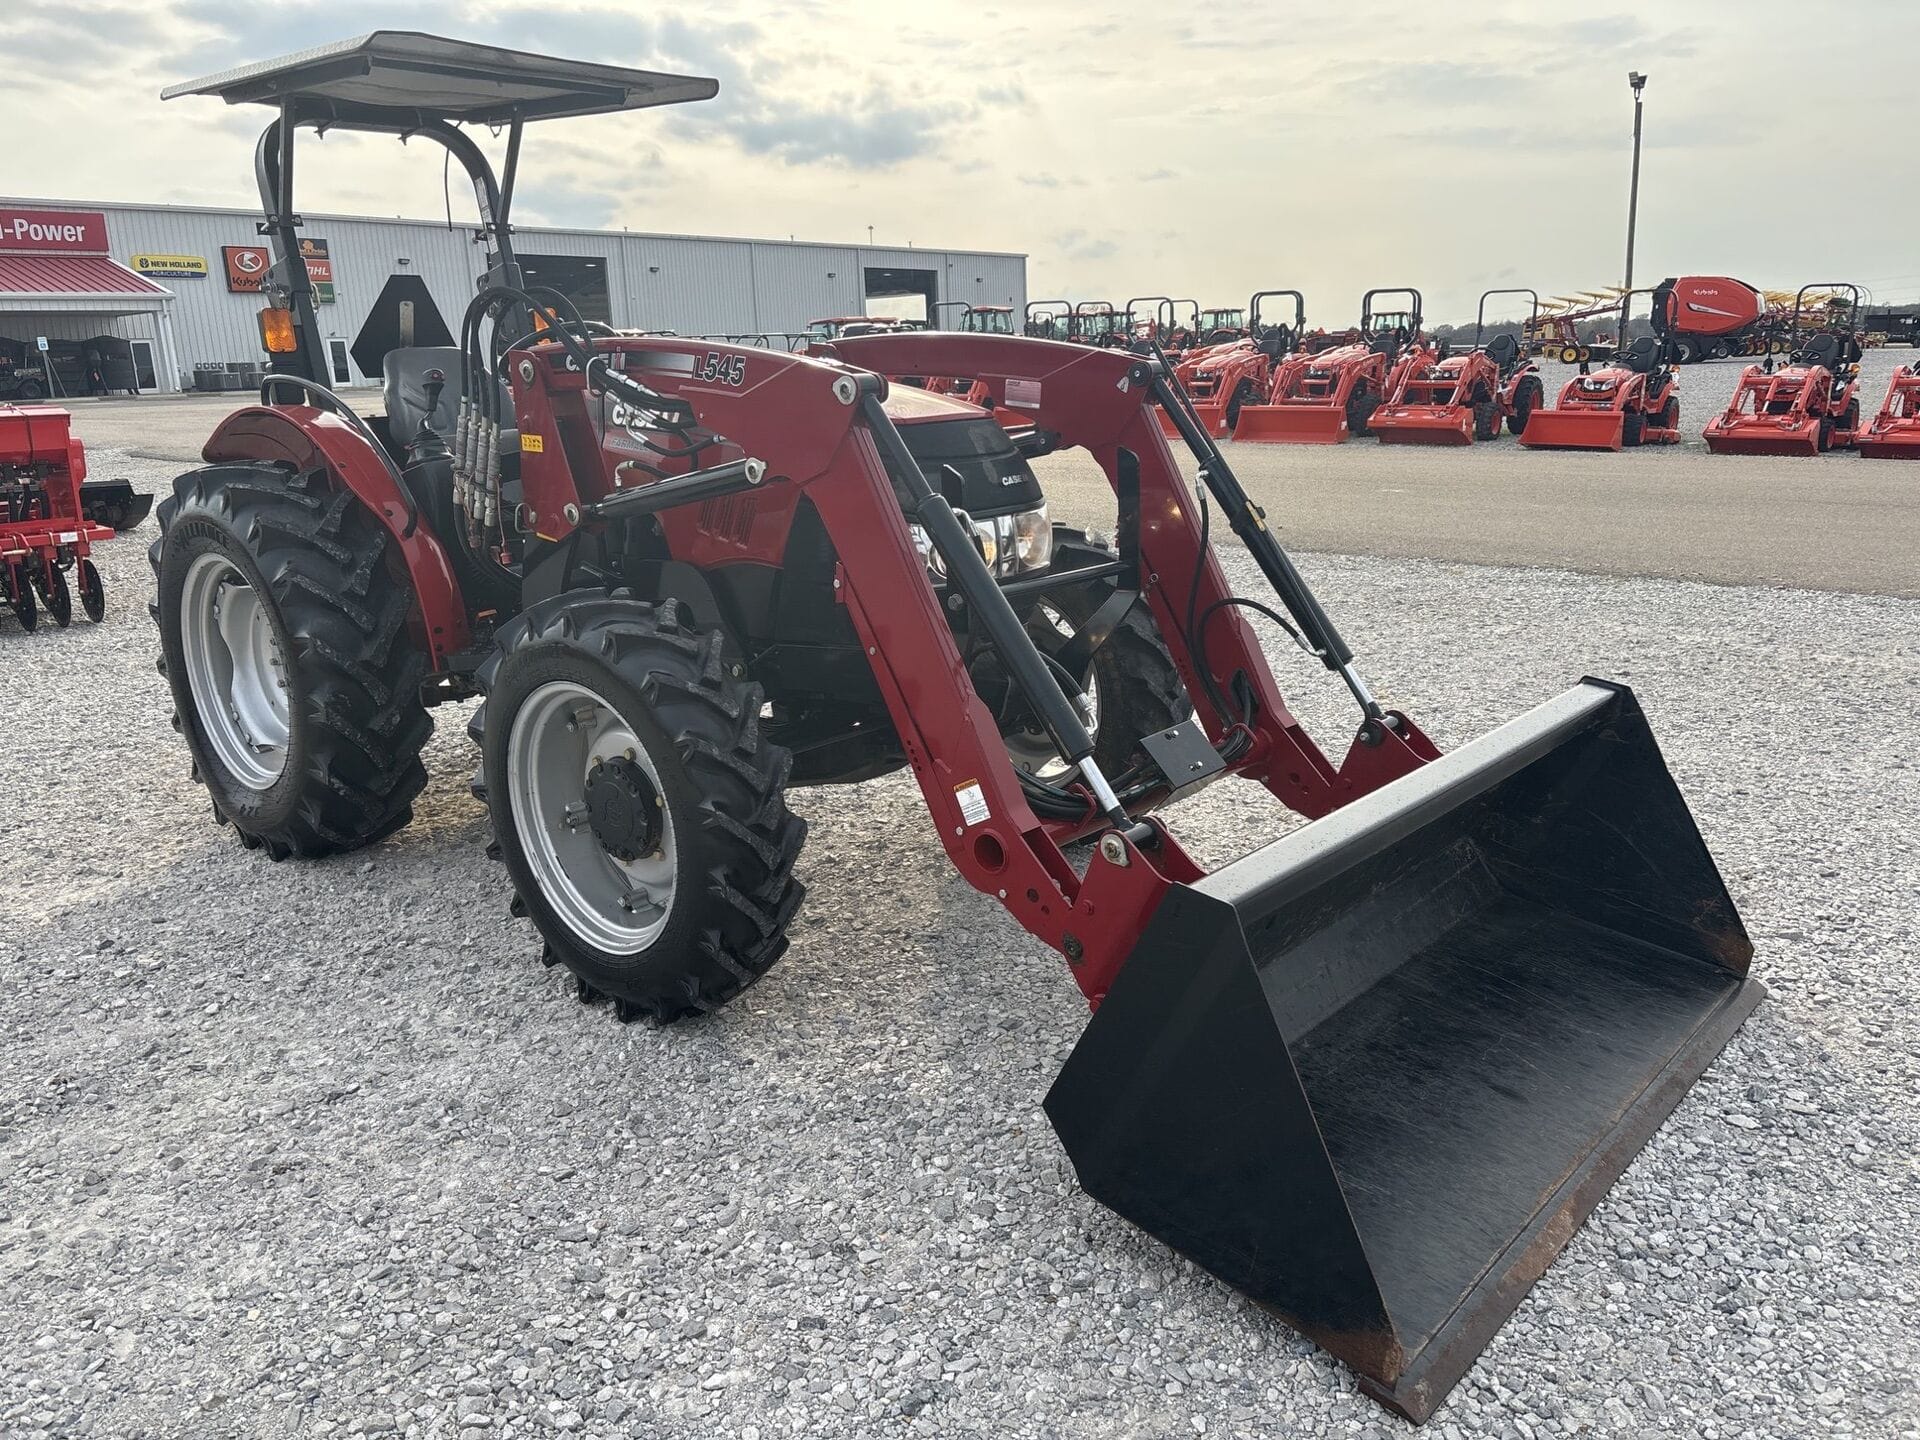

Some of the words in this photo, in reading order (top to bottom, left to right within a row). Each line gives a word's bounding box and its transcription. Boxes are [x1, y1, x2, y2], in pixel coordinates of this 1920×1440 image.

[0, 218, 85, 241] -Power
[694, 351, 746, 387] L545
[1002, 474, 1022, 486] CASE
